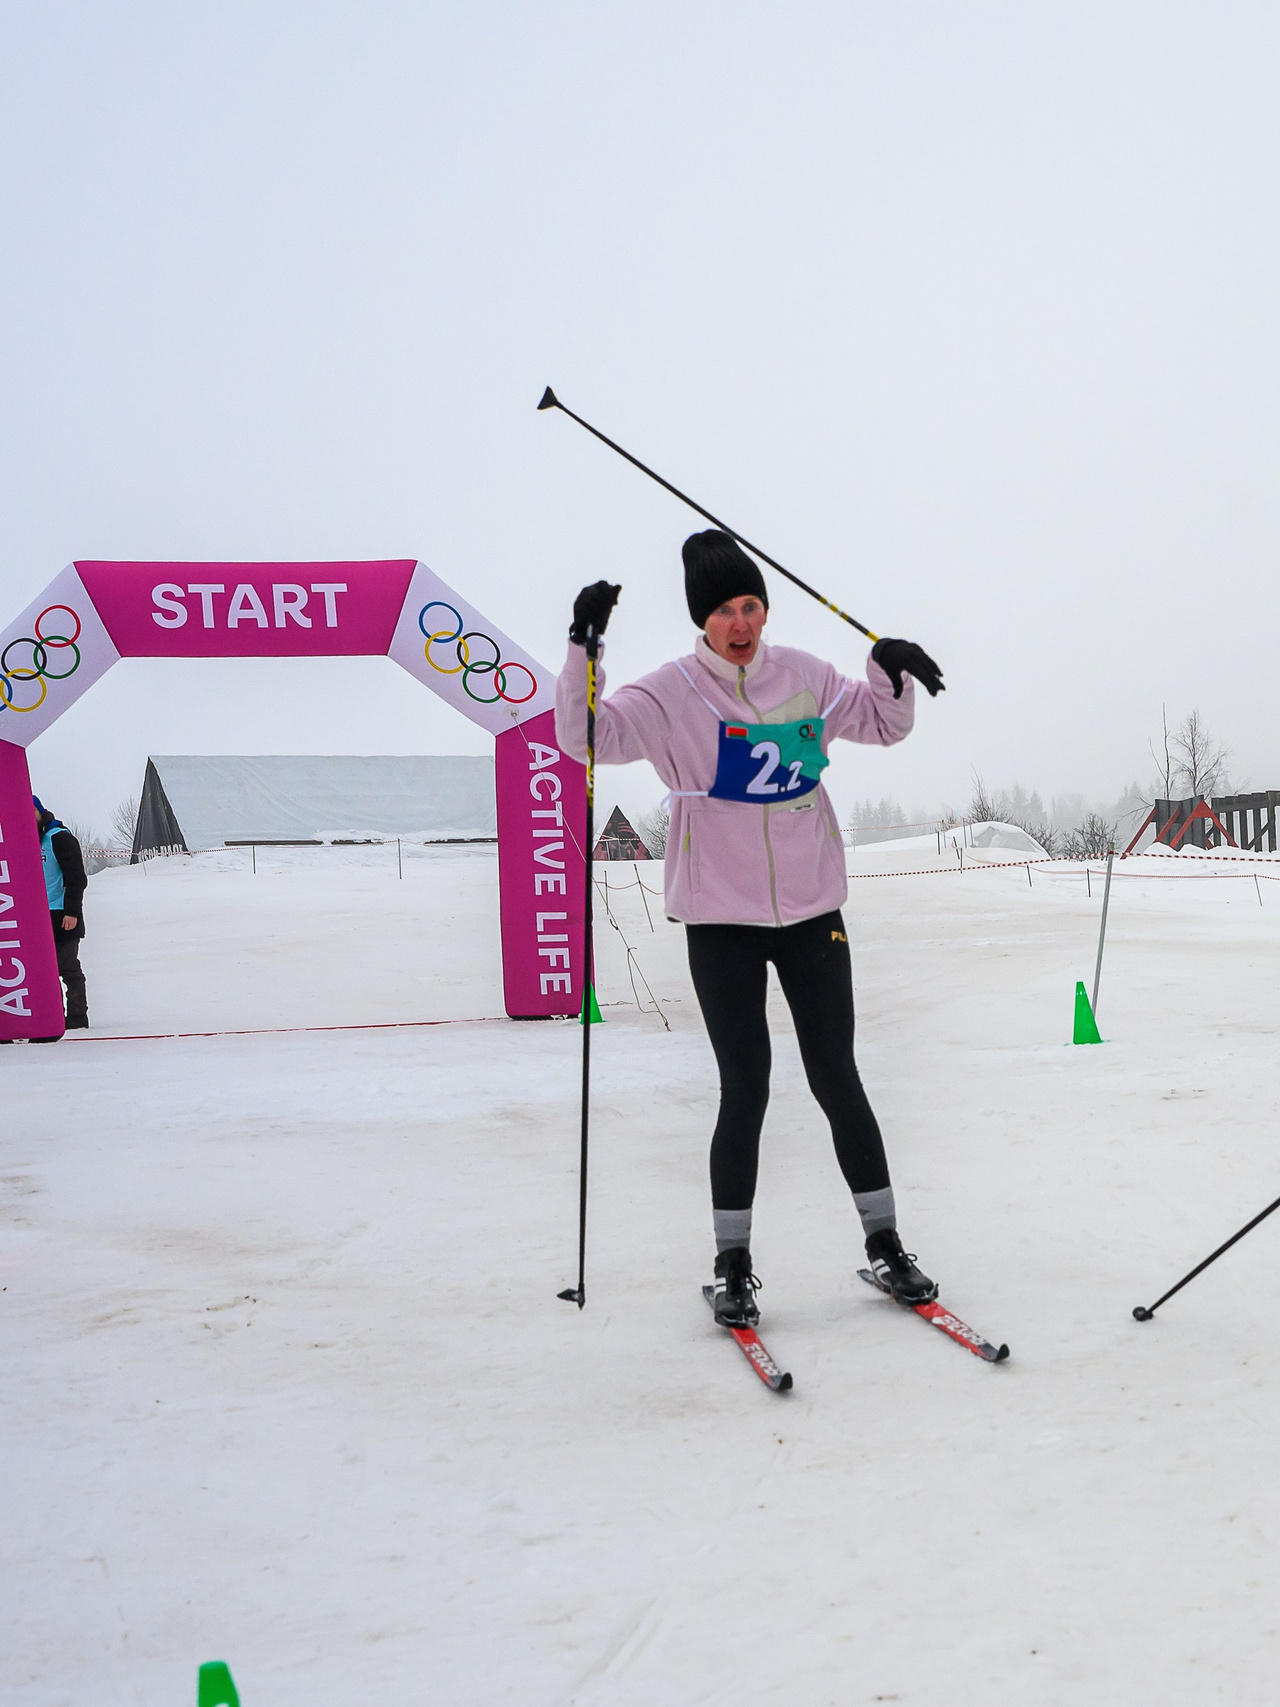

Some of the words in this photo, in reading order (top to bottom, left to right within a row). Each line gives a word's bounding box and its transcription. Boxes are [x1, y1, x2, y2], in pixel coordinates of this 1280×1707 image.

[151, 583, 348, 629] START
[745, 740, 804, 795] 2.2
[528, 742, 566, 896] ACTIVE
[536, 912, 572, 995] LIFE
